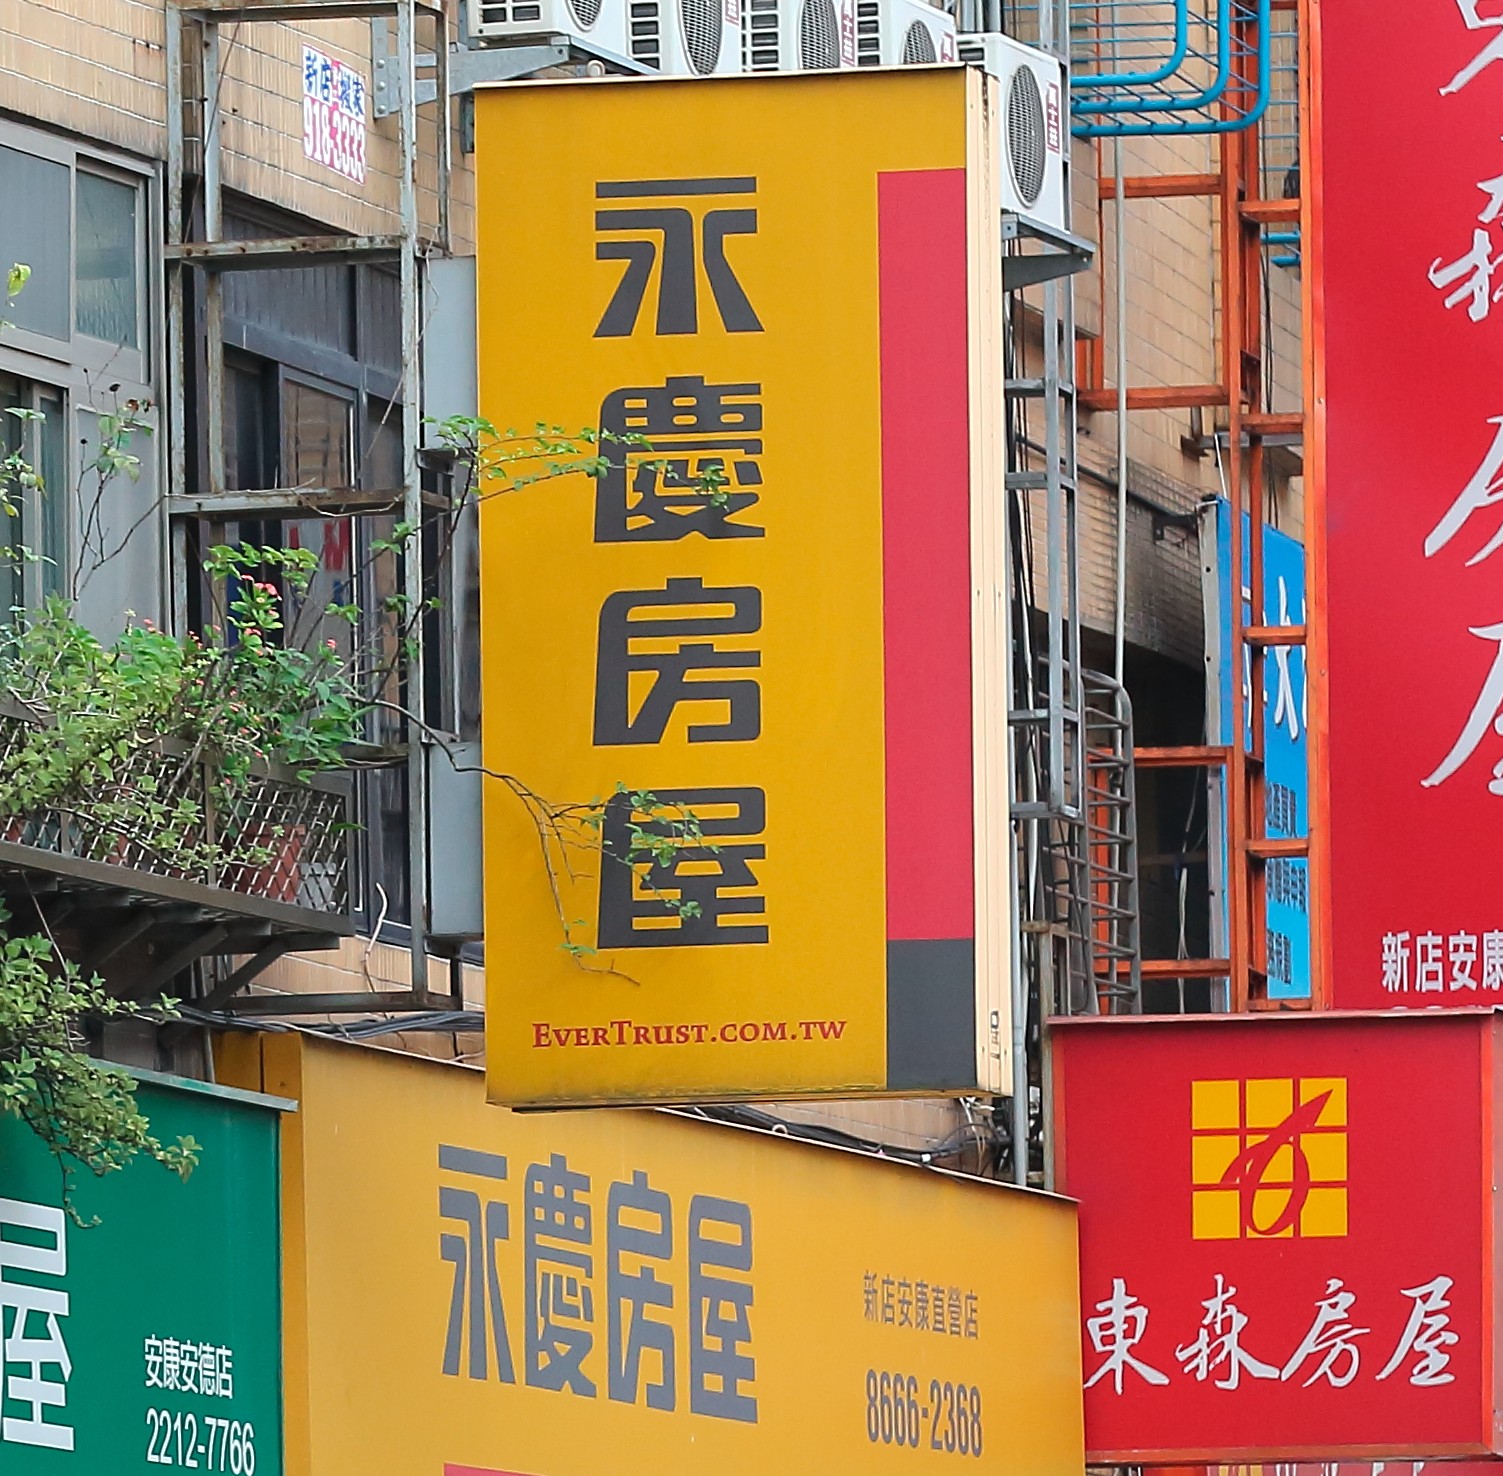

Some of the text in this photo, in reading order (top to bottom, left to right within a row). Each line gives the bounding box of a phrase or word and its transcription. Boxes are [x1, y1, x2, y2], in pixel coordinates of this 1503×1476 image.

[592, 177, 769, 950] 永慶房屋
[438, 1143, 759, 1425] 永慶房屋
[862, 1269, 980, 1342] 新店安康直營店
[144, 1334, 234, 1399] 安康安德店
[1083, 1273, 1459, 1396] 東森房屋
[146, 1408, 255, 1476] 2212-7766
[865, 1369, 983, 1458] 8666-2368
